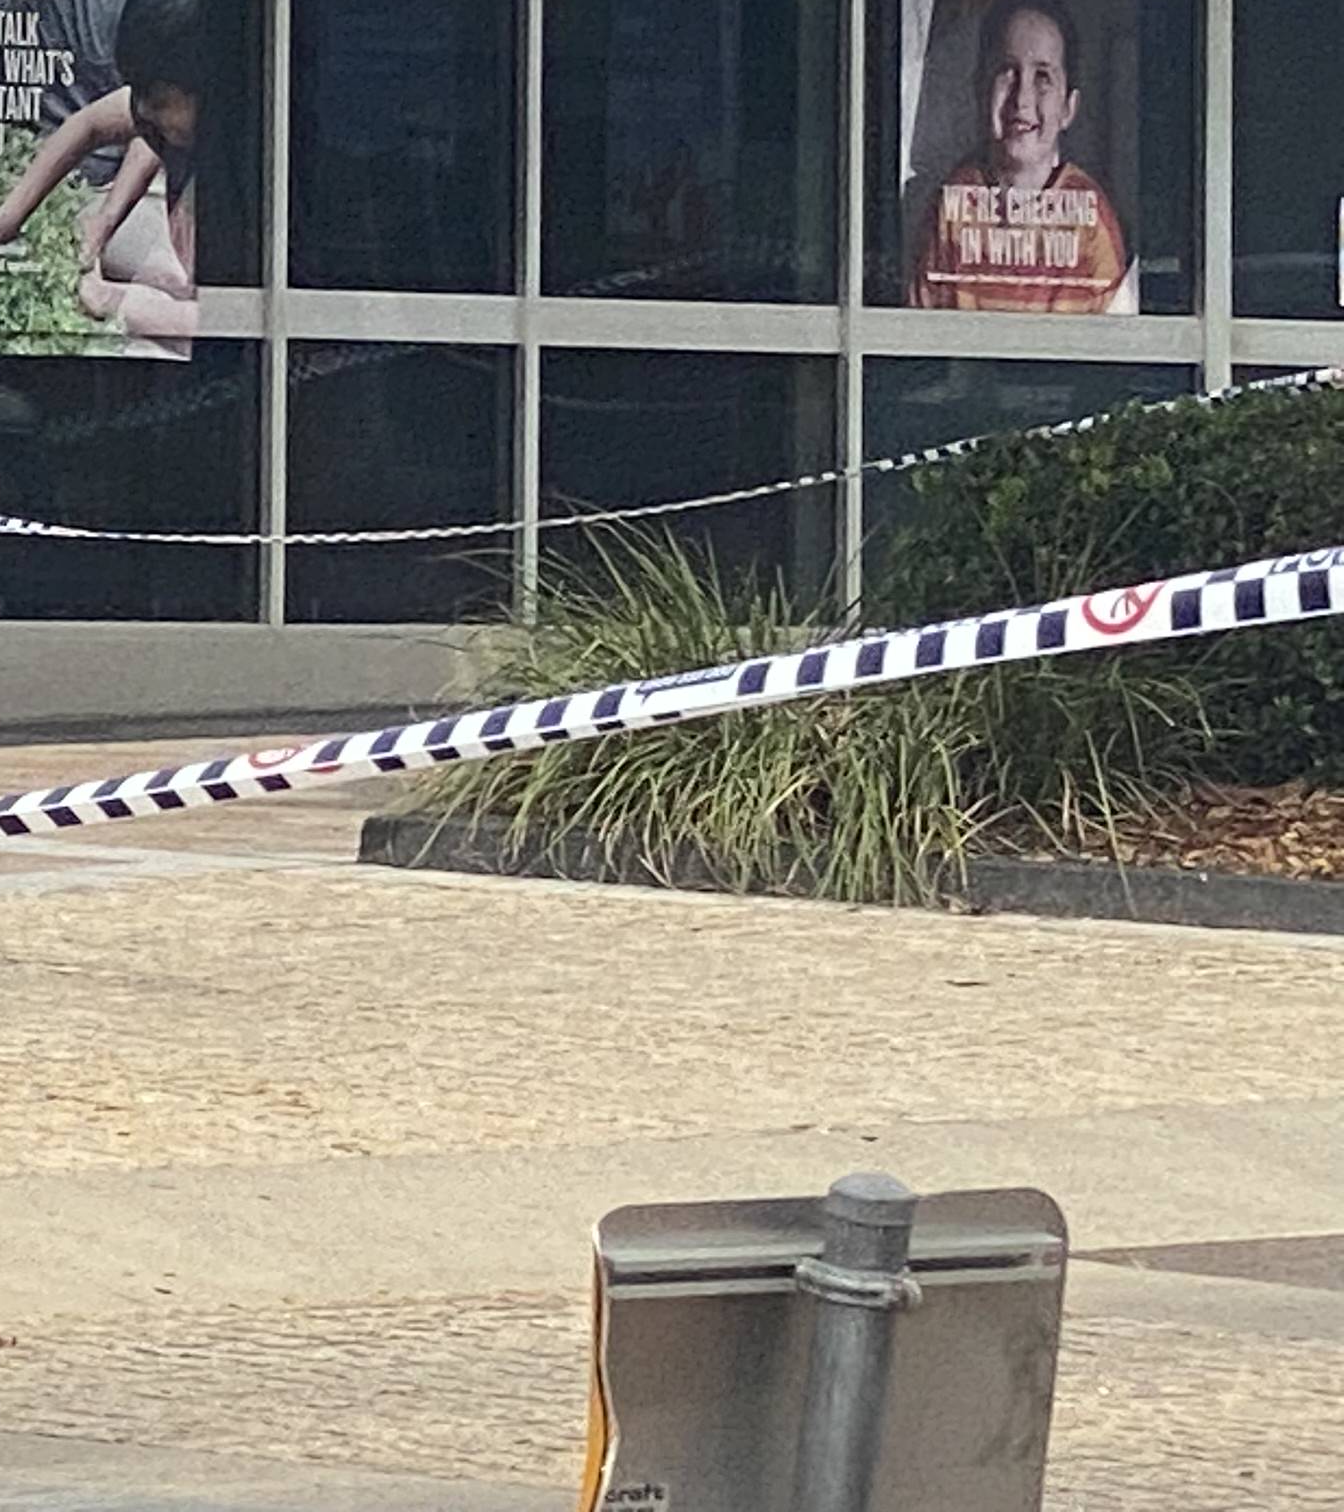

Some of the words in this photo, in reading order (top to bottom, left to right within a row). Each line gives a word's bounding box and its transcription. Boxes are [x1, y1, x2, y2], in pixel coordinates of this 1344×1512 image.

[4, 49, 75, 87] WHAT'S
[943, 185, 1001, 224] WE'RE
[1006, 187, 1099, 227] CHECKING
[960, 228, 982, 264] IN
[988, 228, 1036, 267] WITH
[1043, 230, 1081, 268] YOU
